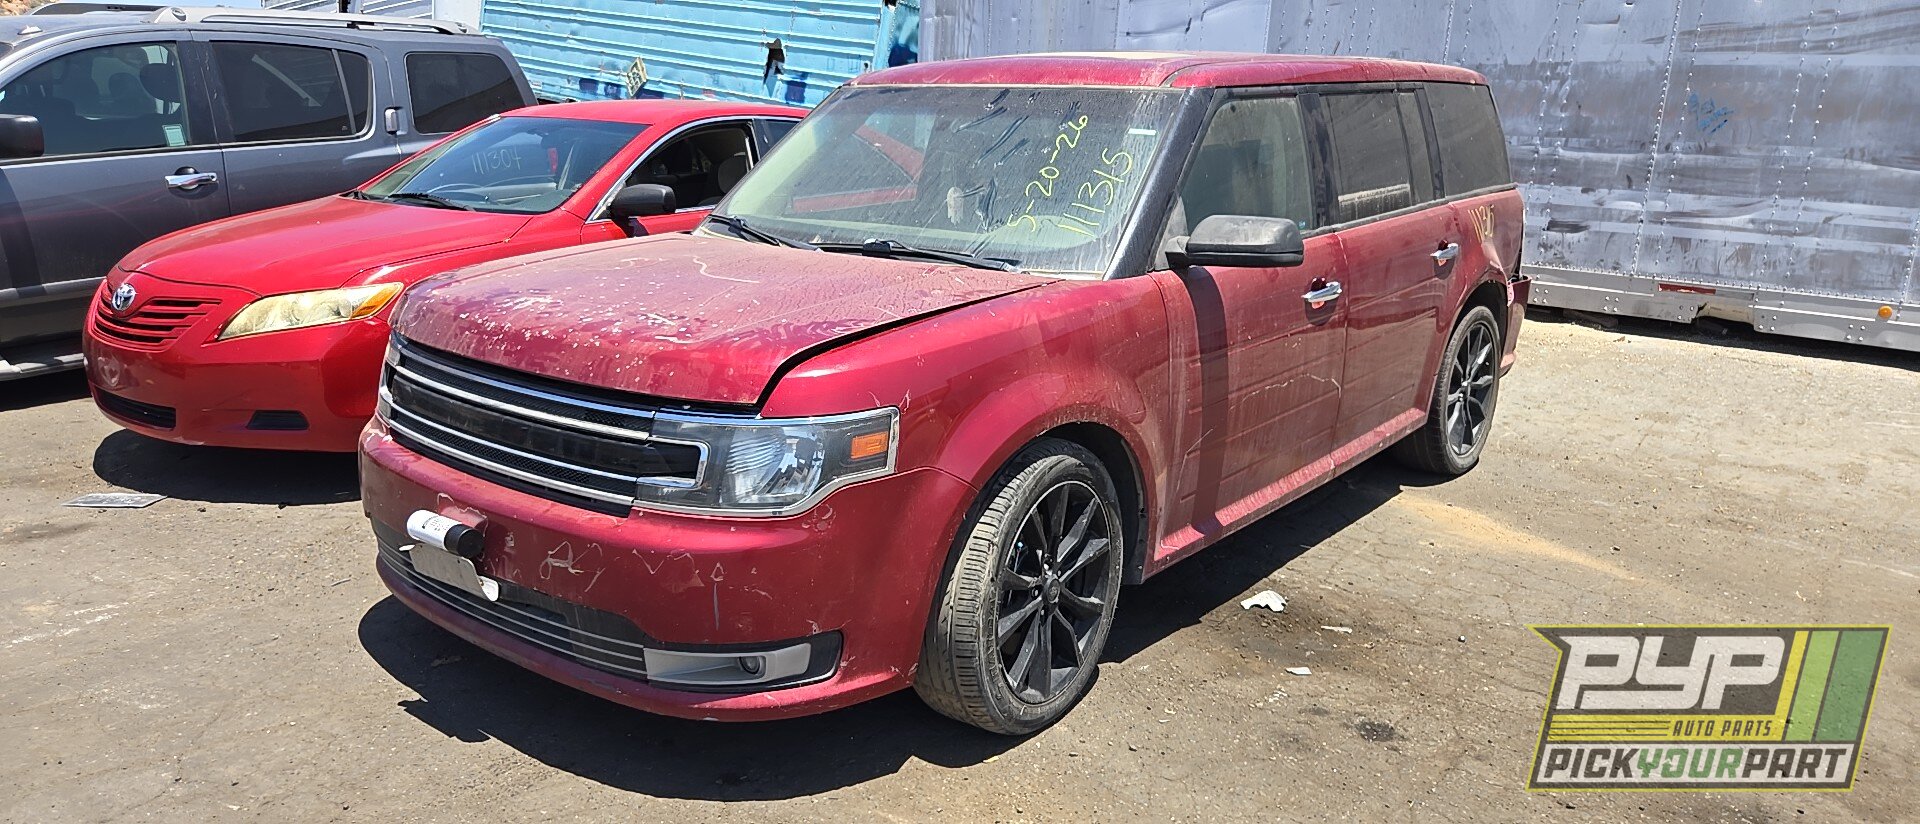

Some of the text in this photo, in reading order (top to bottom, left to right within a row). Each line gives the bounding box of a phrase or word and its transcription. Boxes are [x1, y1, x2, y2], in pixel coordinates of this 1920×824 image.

[471, 146, 522, 175] 111304
[1006, 115, 1089, 232] 5-20-26
[1057, 148, 1133, 242] 111315
